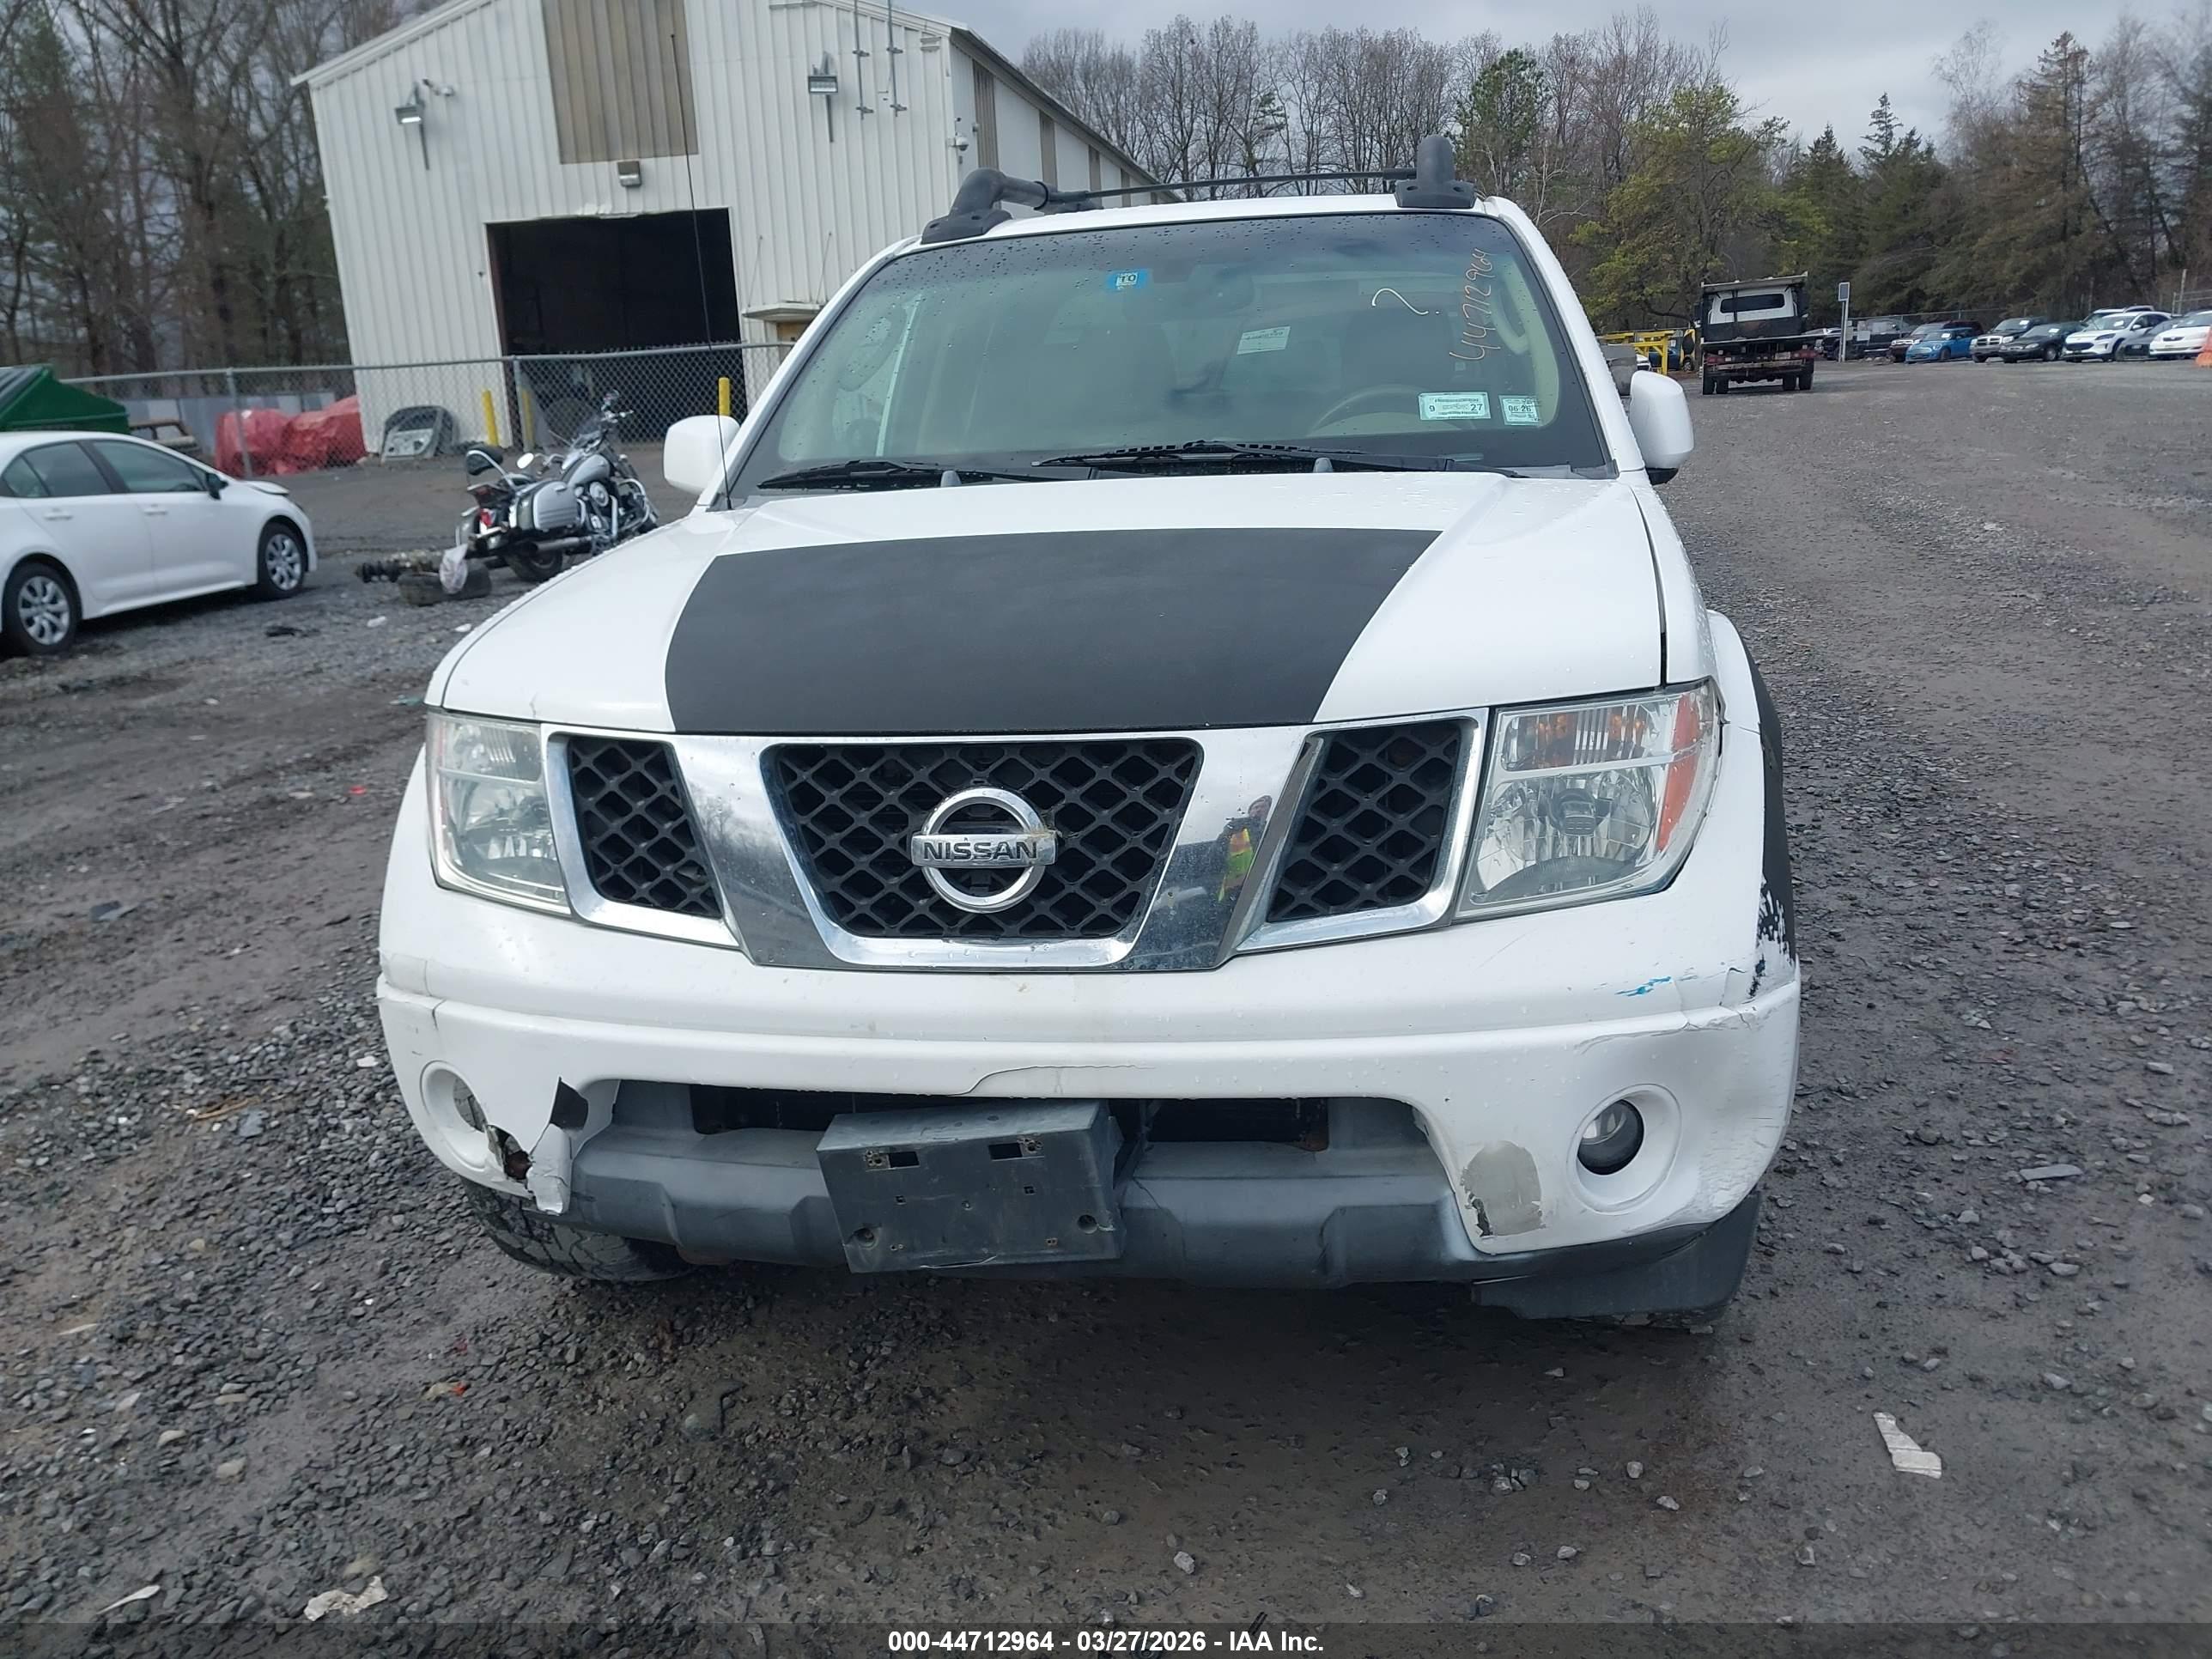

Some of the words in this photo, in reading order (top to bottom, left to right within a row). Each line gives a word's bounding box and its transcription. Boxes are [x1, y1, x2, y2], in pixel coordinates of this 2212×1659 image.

[1449, 246, 1501, 361] 44712964
[1470, 403, 1483, 411] 27
[923, 841, 1037, 860] NISSAN
